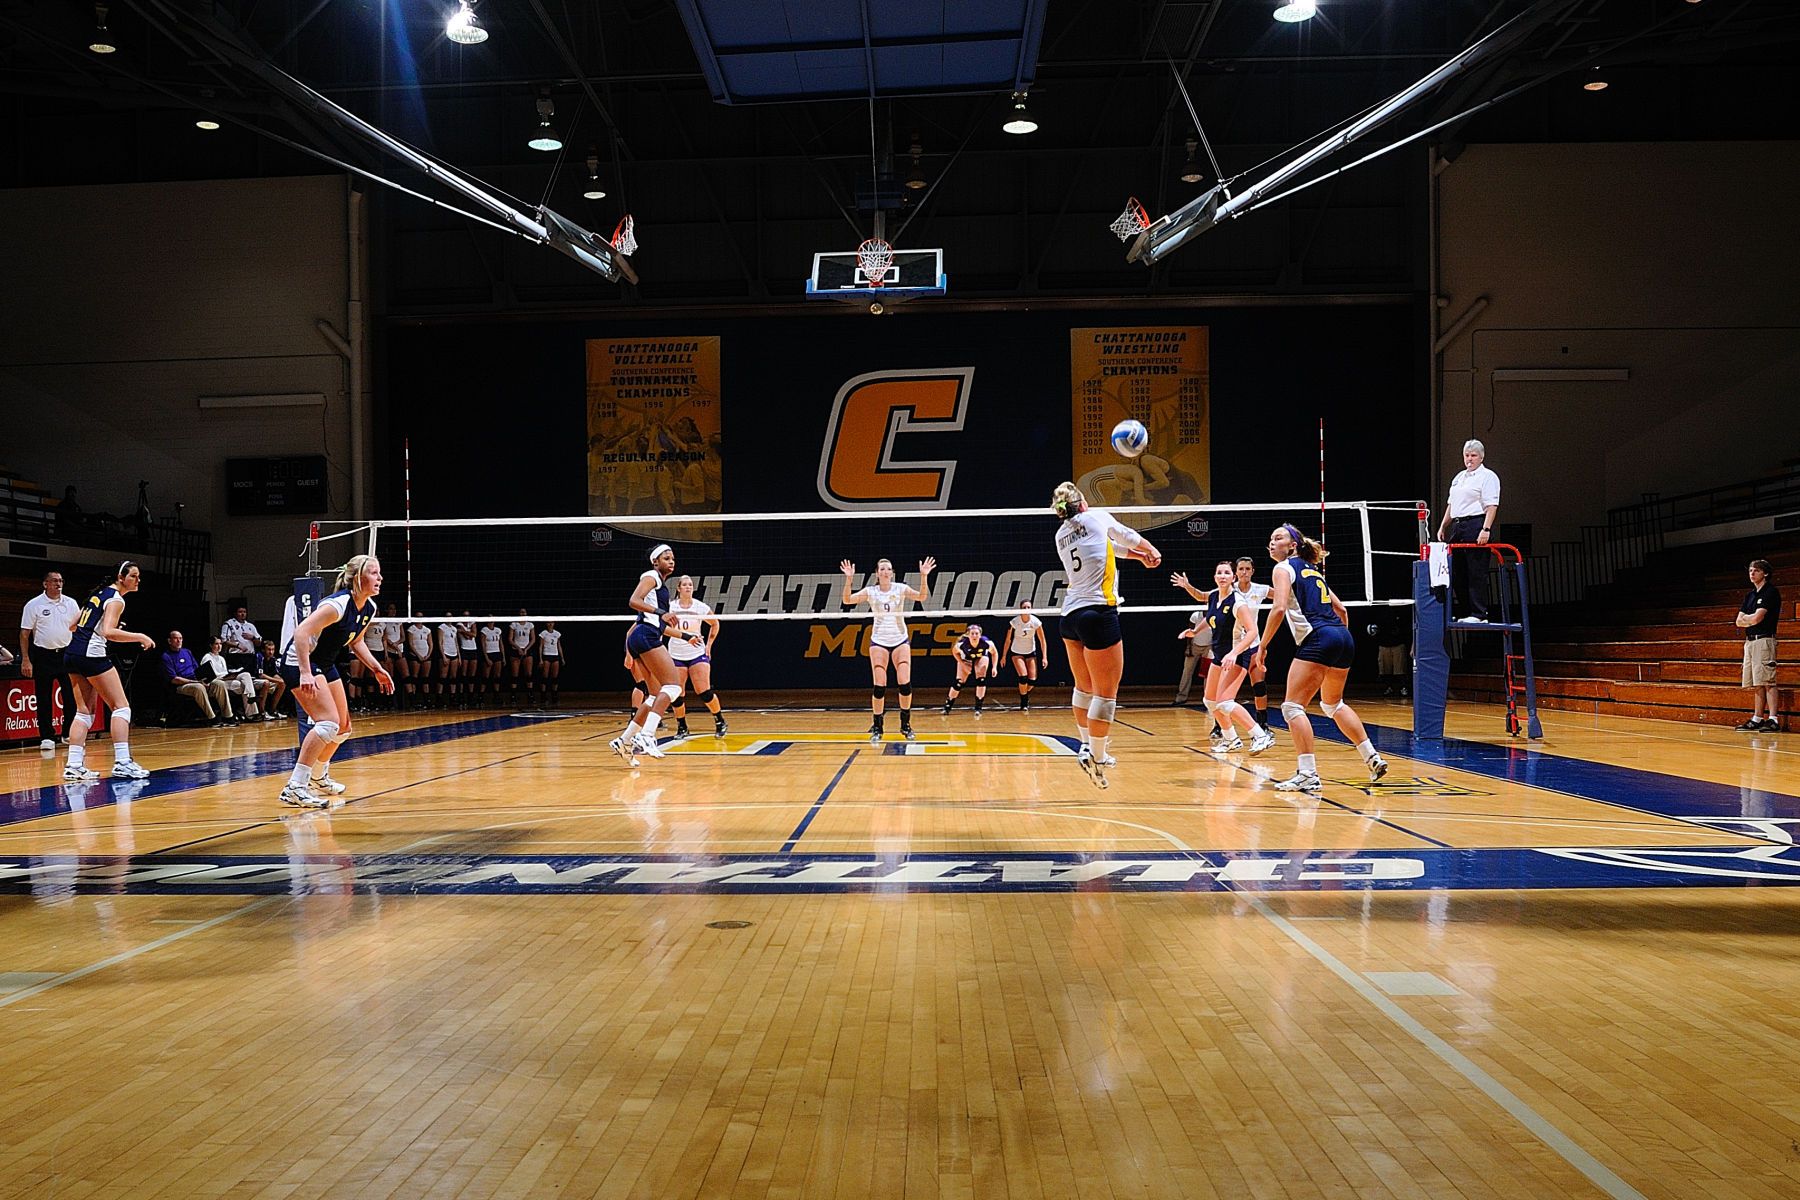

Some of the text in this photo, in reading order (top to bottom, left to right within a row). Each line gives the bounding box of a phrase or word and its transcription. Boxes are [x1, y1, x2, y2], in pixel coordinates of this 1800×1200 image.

[1094, 332, 1187, 343] CHATTANOOGA
[608, 343, 699, 354] CHATTANOOGA
[1103, 344, 1180, 355] WRESTLING
[614, 354, 693, 365] VOLLEYBALL
[1098, 357, 1183, 366] SOUTHERN CONFERENCE
[611, 367, 695, 376] SOUTHERN CONFERENCE
[1103, 365, 1178, 376] CHAMPIONS
[610, 375, 698, 386] TOURNAMENT
[617, 387, 690, 399] CHAMPIONS
[692, 400, 712, 408] 1997
[817, 367, 975, 511] C
[1179, 437, 1200, 445] 2009
[603, 451, 705, 463] REGULAR SEASON
[1187, 520, 1208, 533] SOCON
[591, 530, 613, 542] SOCON
[1070, 547, 1082, 572] 5
[1316, 579, 1331, 603] 2
[883, 603, 891, 612] 9
[5, 716, 32, 730] Relax.
